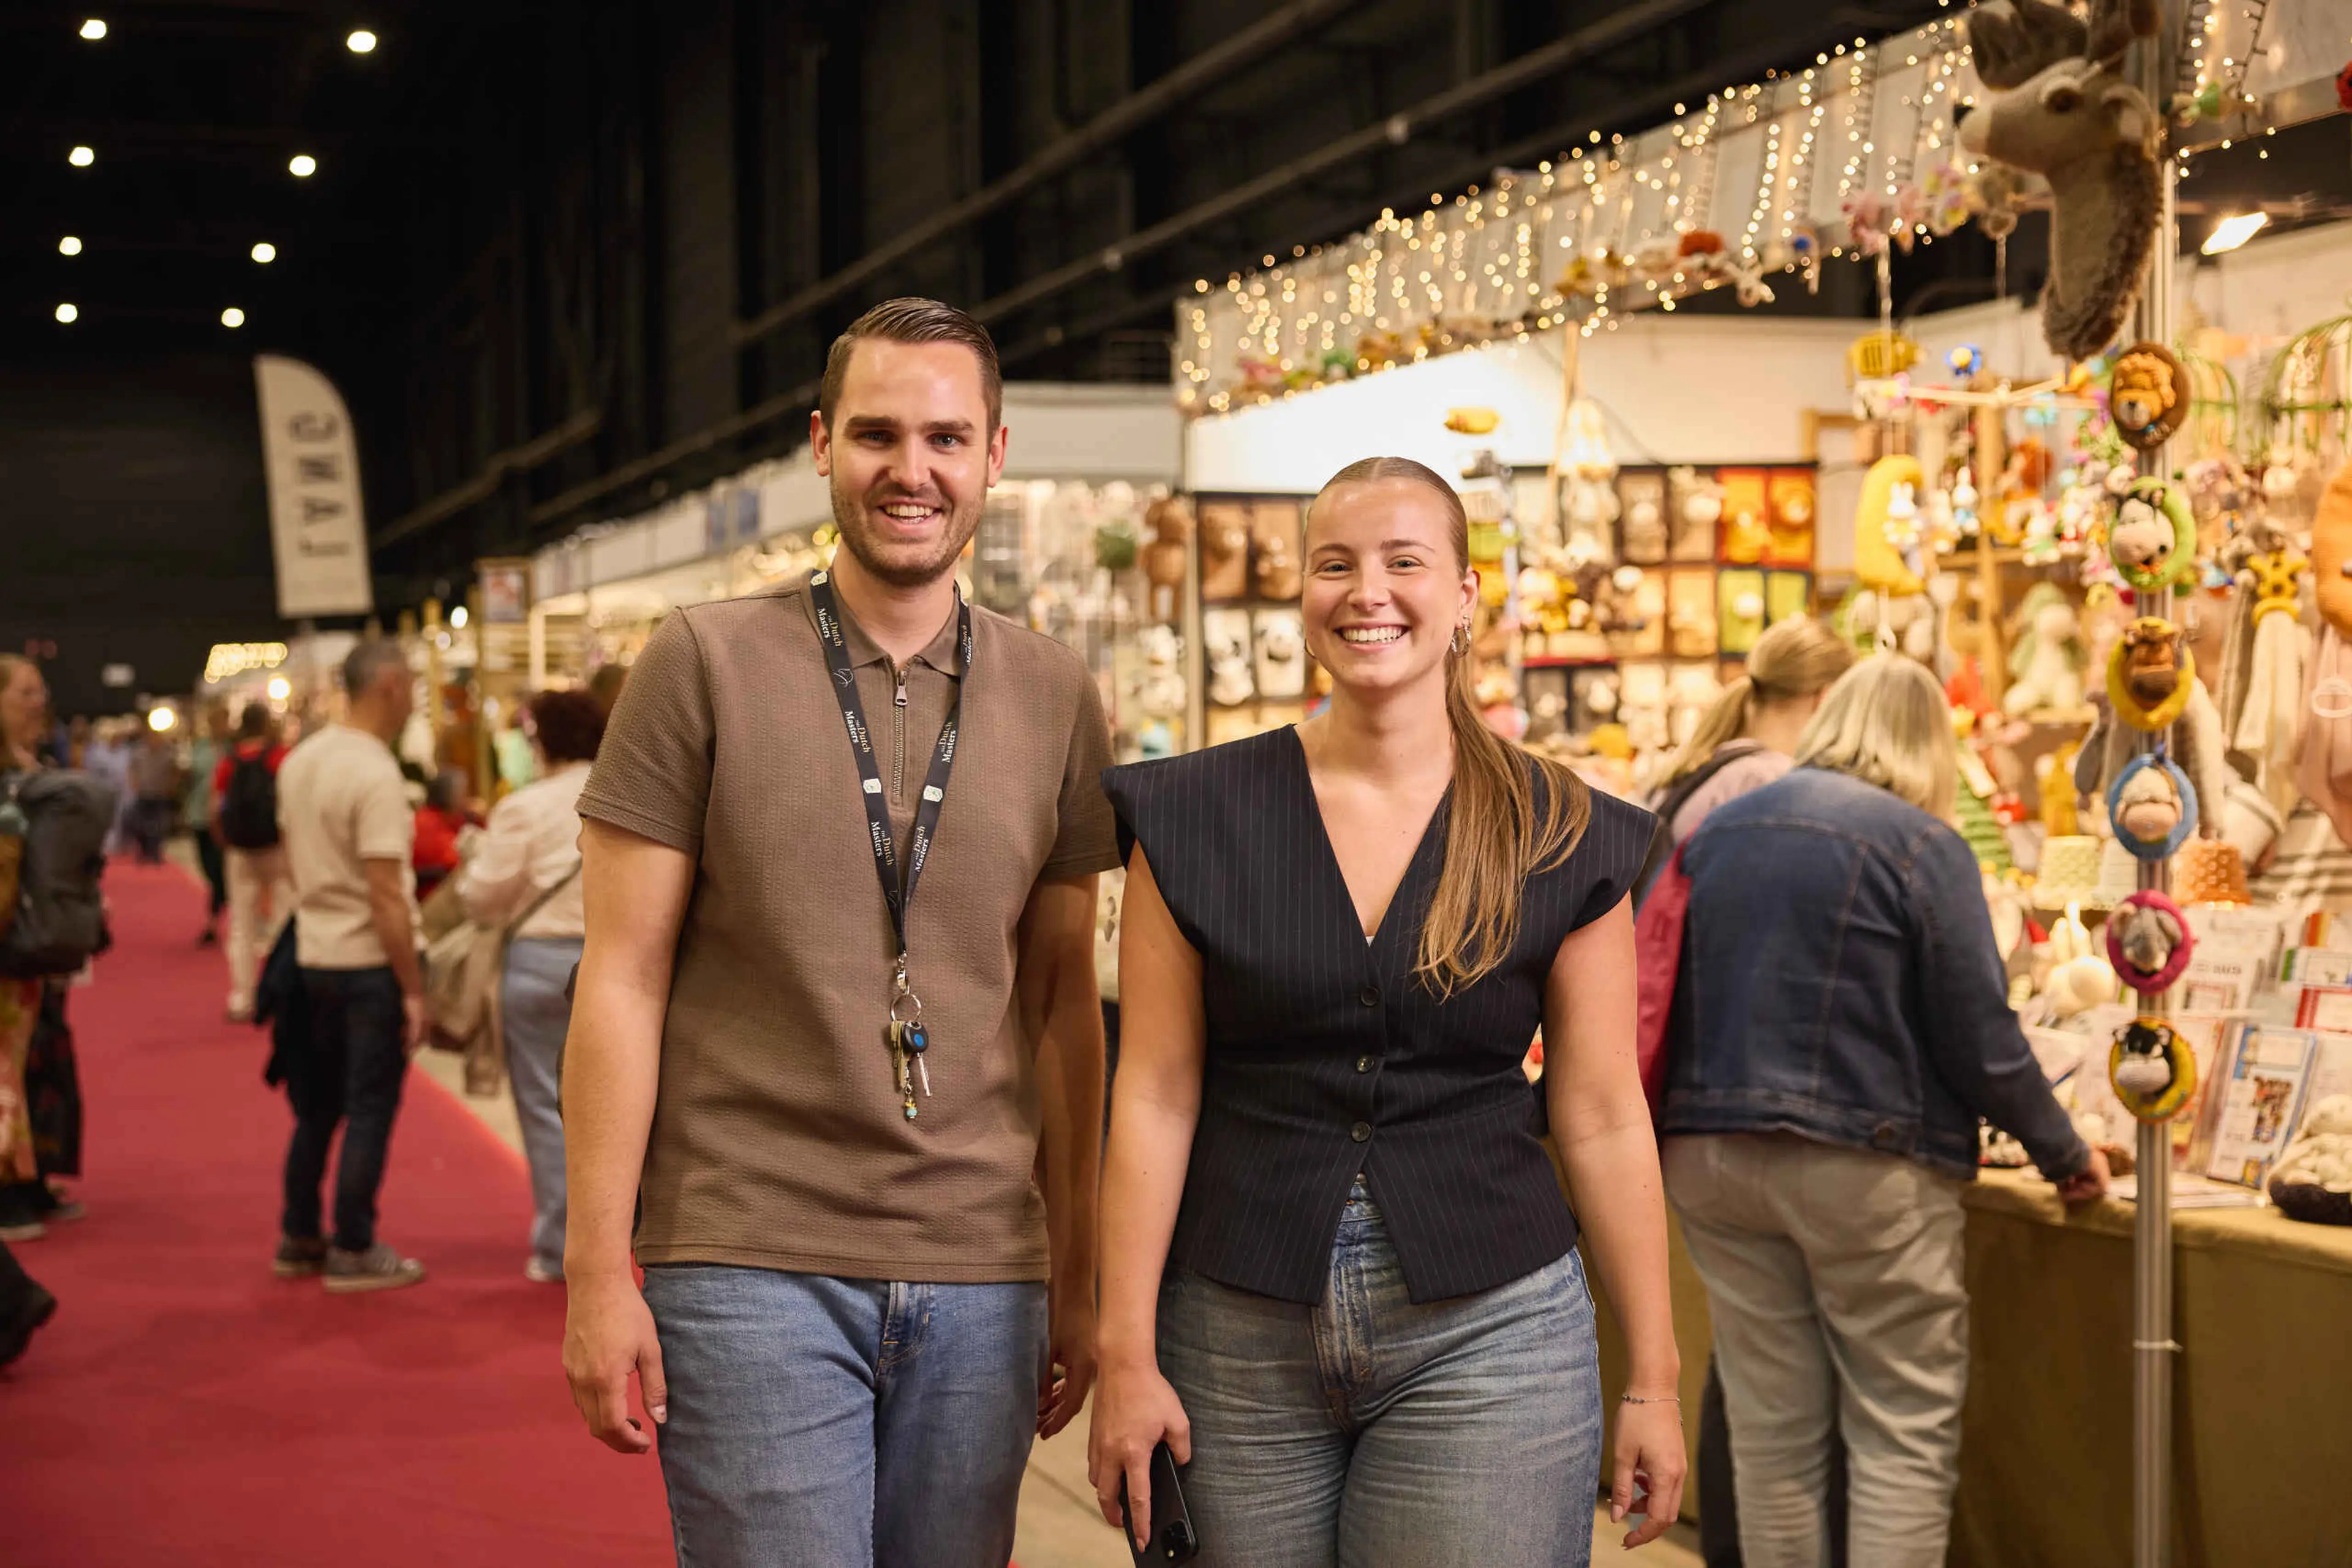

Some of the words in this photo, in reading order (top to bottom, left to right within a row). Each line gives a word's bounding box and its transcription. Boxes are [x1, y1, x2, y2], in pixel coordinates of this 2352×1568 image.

[817, 608, 831, 638] Masters
[830, 622, 843, 647] Dutch
[845, 710, 859, 743] Masters
[858, 727, 872, 753] Dutch
[938, 722, 953, 745] Dutch
[941, 729, 956, 763] Masters
[871, 821, 883, 857] Masters
[883, 837, 895, 865] Dutch
[913, 826, 925, 852] Dutch
[914, 839, 929, 872] Masters
